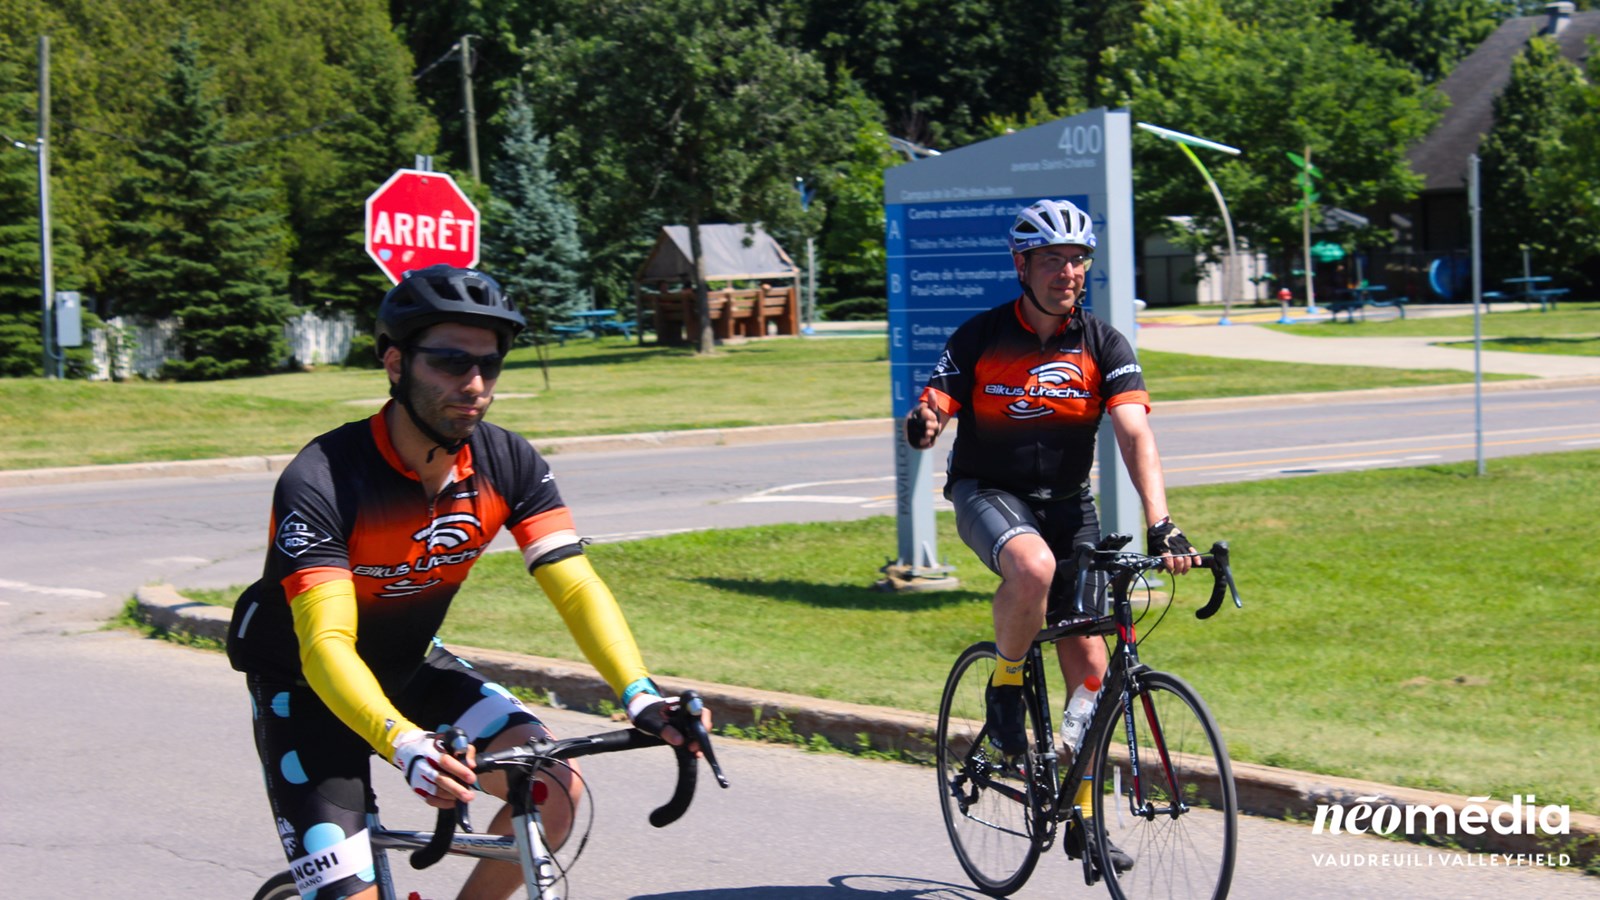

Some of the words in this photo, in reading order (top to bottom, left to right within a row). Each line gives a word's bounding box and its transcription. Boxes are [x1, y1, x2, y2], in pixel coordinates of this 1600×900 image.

[1058, 125, 1102, 155] 400
[1010, 163, 1040, 172] avenue
[1041, 157, 1096, 171] Saint-Charles
[908, 208, 938, 219] Centre
[940, 204, 994, 218] administratif
[995, 206, 1005, 216] et
[373, 210, 473, 252] ARRÊT
[888, 219, 901, 239] A
[890, 273, 902, 293] B
[911, 269, 939, 281] Centre
[942, 268, 953, 280] de
[954, 268, 997, 280] formation
[893, 327, 903, 347] E
[912, 324, 941, 335] Centre
[895, 381, 905, 400] L
[984, 384, 1026, 396] Bikus
[353, 562, 411, 578] Bikus
